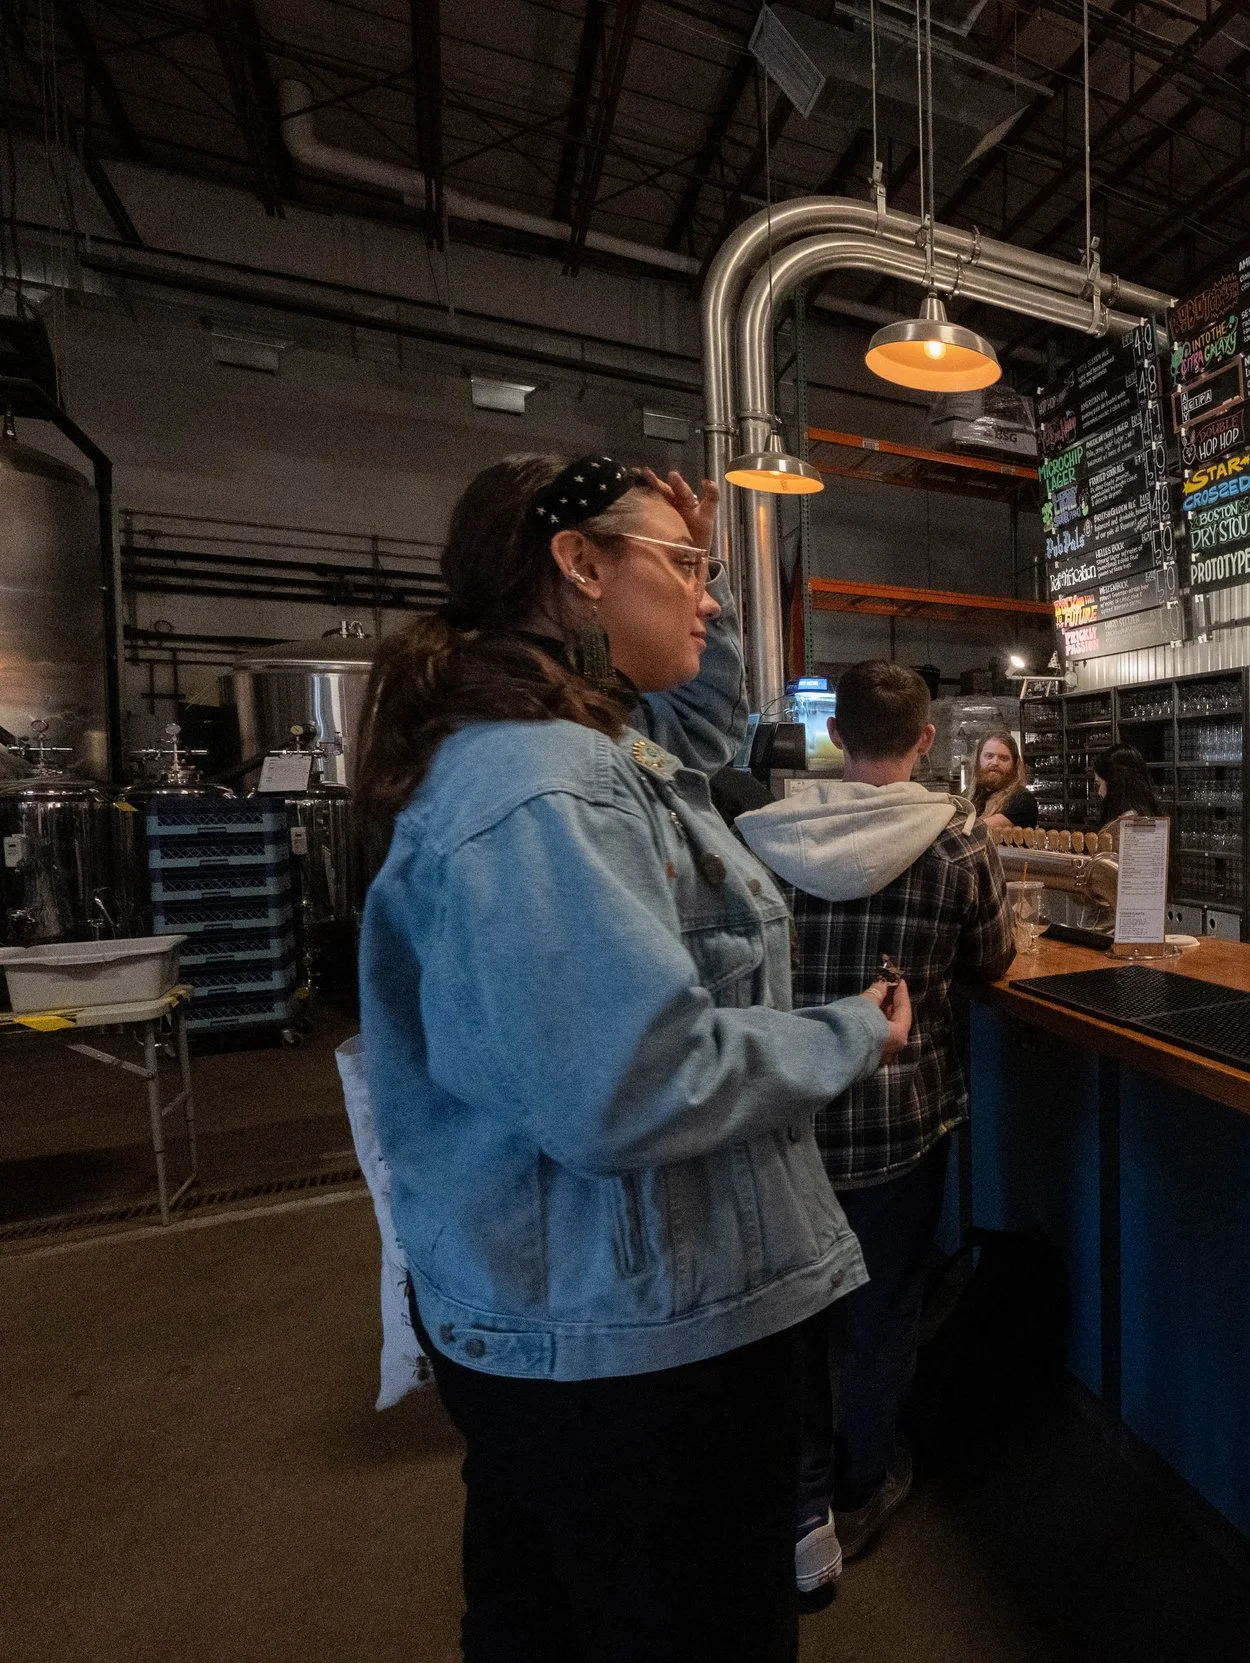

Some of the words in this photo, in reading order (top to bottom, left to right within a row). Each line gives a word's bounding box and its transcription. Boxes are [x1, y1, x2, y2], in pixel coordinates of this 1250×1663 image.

[1192, 332, 1211, 350] INTO
[1211, 321, 1228, 341] THE
[1204, 331, 1236, 362] GALAXY
[1200, 415, 1238, 441] DOUBLE
[1198, 436, 1218, 460] HOP
[1219, 427, 1239, 450] HOP
[1038, 446, 1083, 482] MICROCHIP
[1155, 445, 1165, 474] 9
[1190, 457, 1243, 490] STAR
[1046, 467, 1077, 494] LAGER
[1161, 486, 1170, 513] 8
[1199, 500, 1239, 526] BOSTON
[1095, 545, 1112, 559] HELLES
[1112, 541, 1125, 553] BOCK
[1163, 526, 1172, 555] 9
[1190, 523, 1218, 550] DRY
